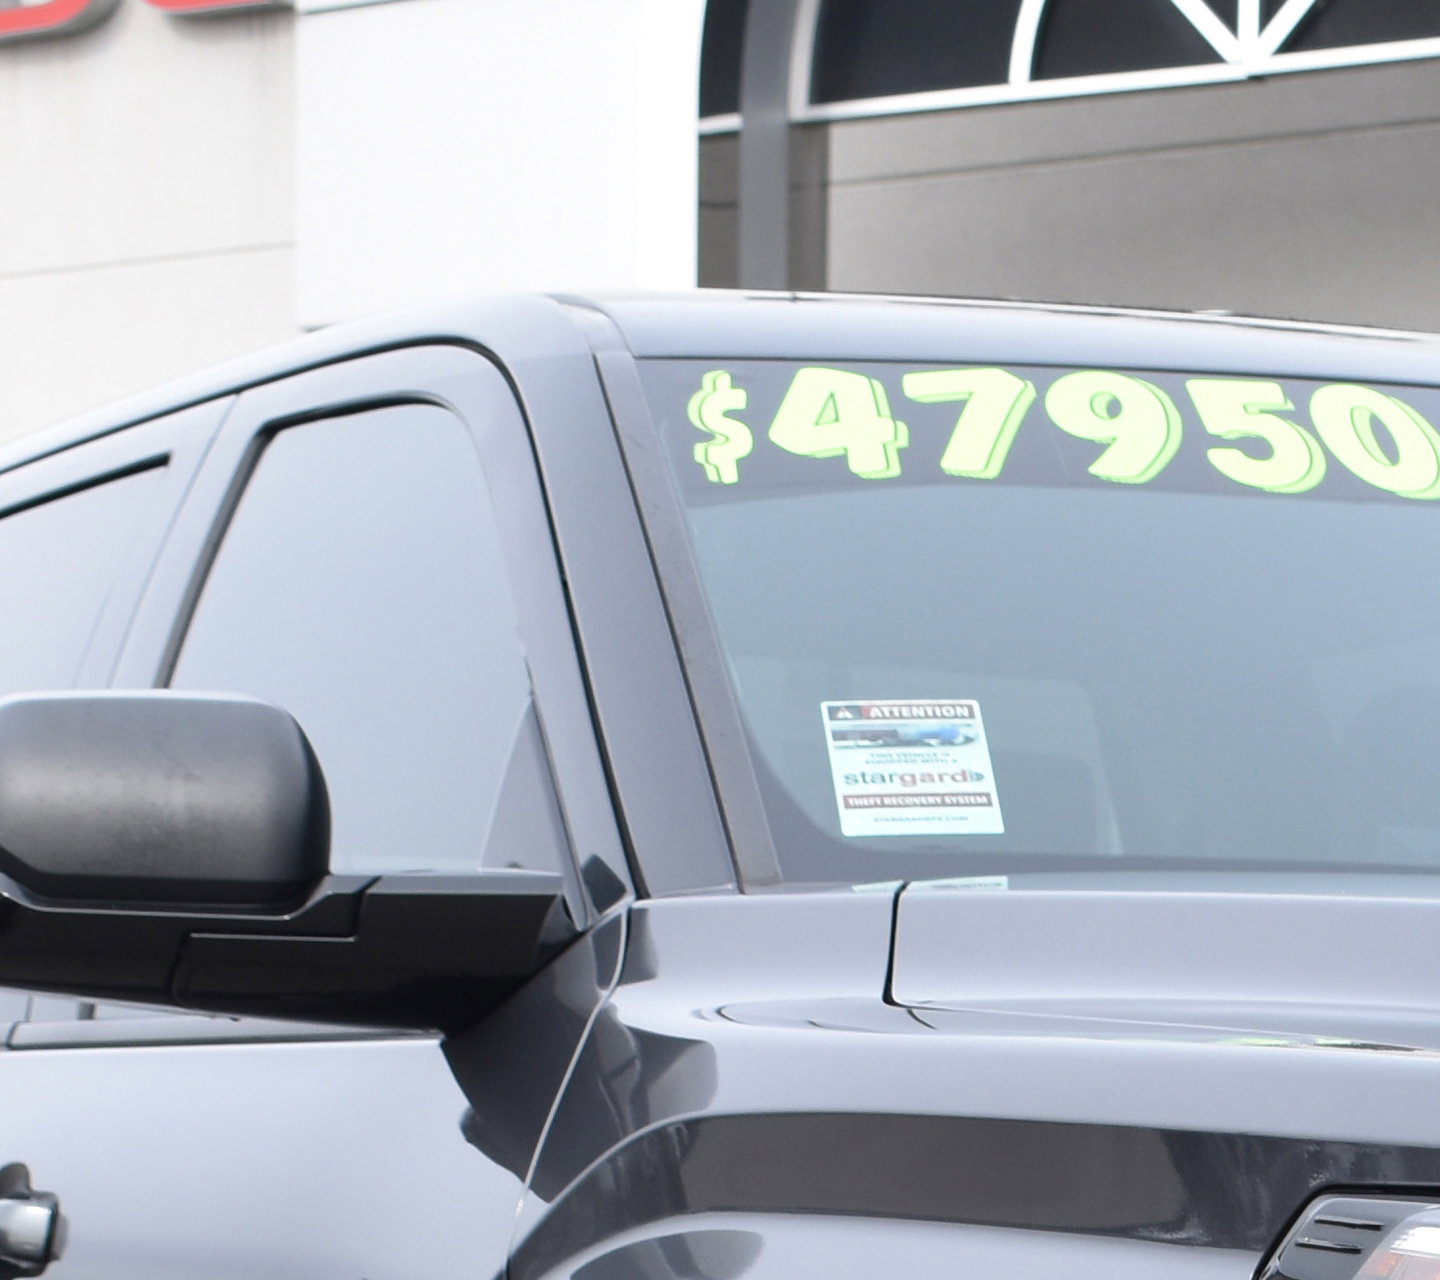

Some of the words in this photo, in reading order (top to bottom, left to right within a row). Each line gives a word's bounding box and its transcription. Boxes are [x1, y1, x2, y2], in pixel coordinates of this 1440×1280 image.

[870, 704, 970, 719] ATTENTION
[844, 769, 969, 787] stargard
[846, 797, 881, 808] THEFT
[883, 796, 942, 806] RECOVERY
[943, 794, 988, 805] SYSTEM
